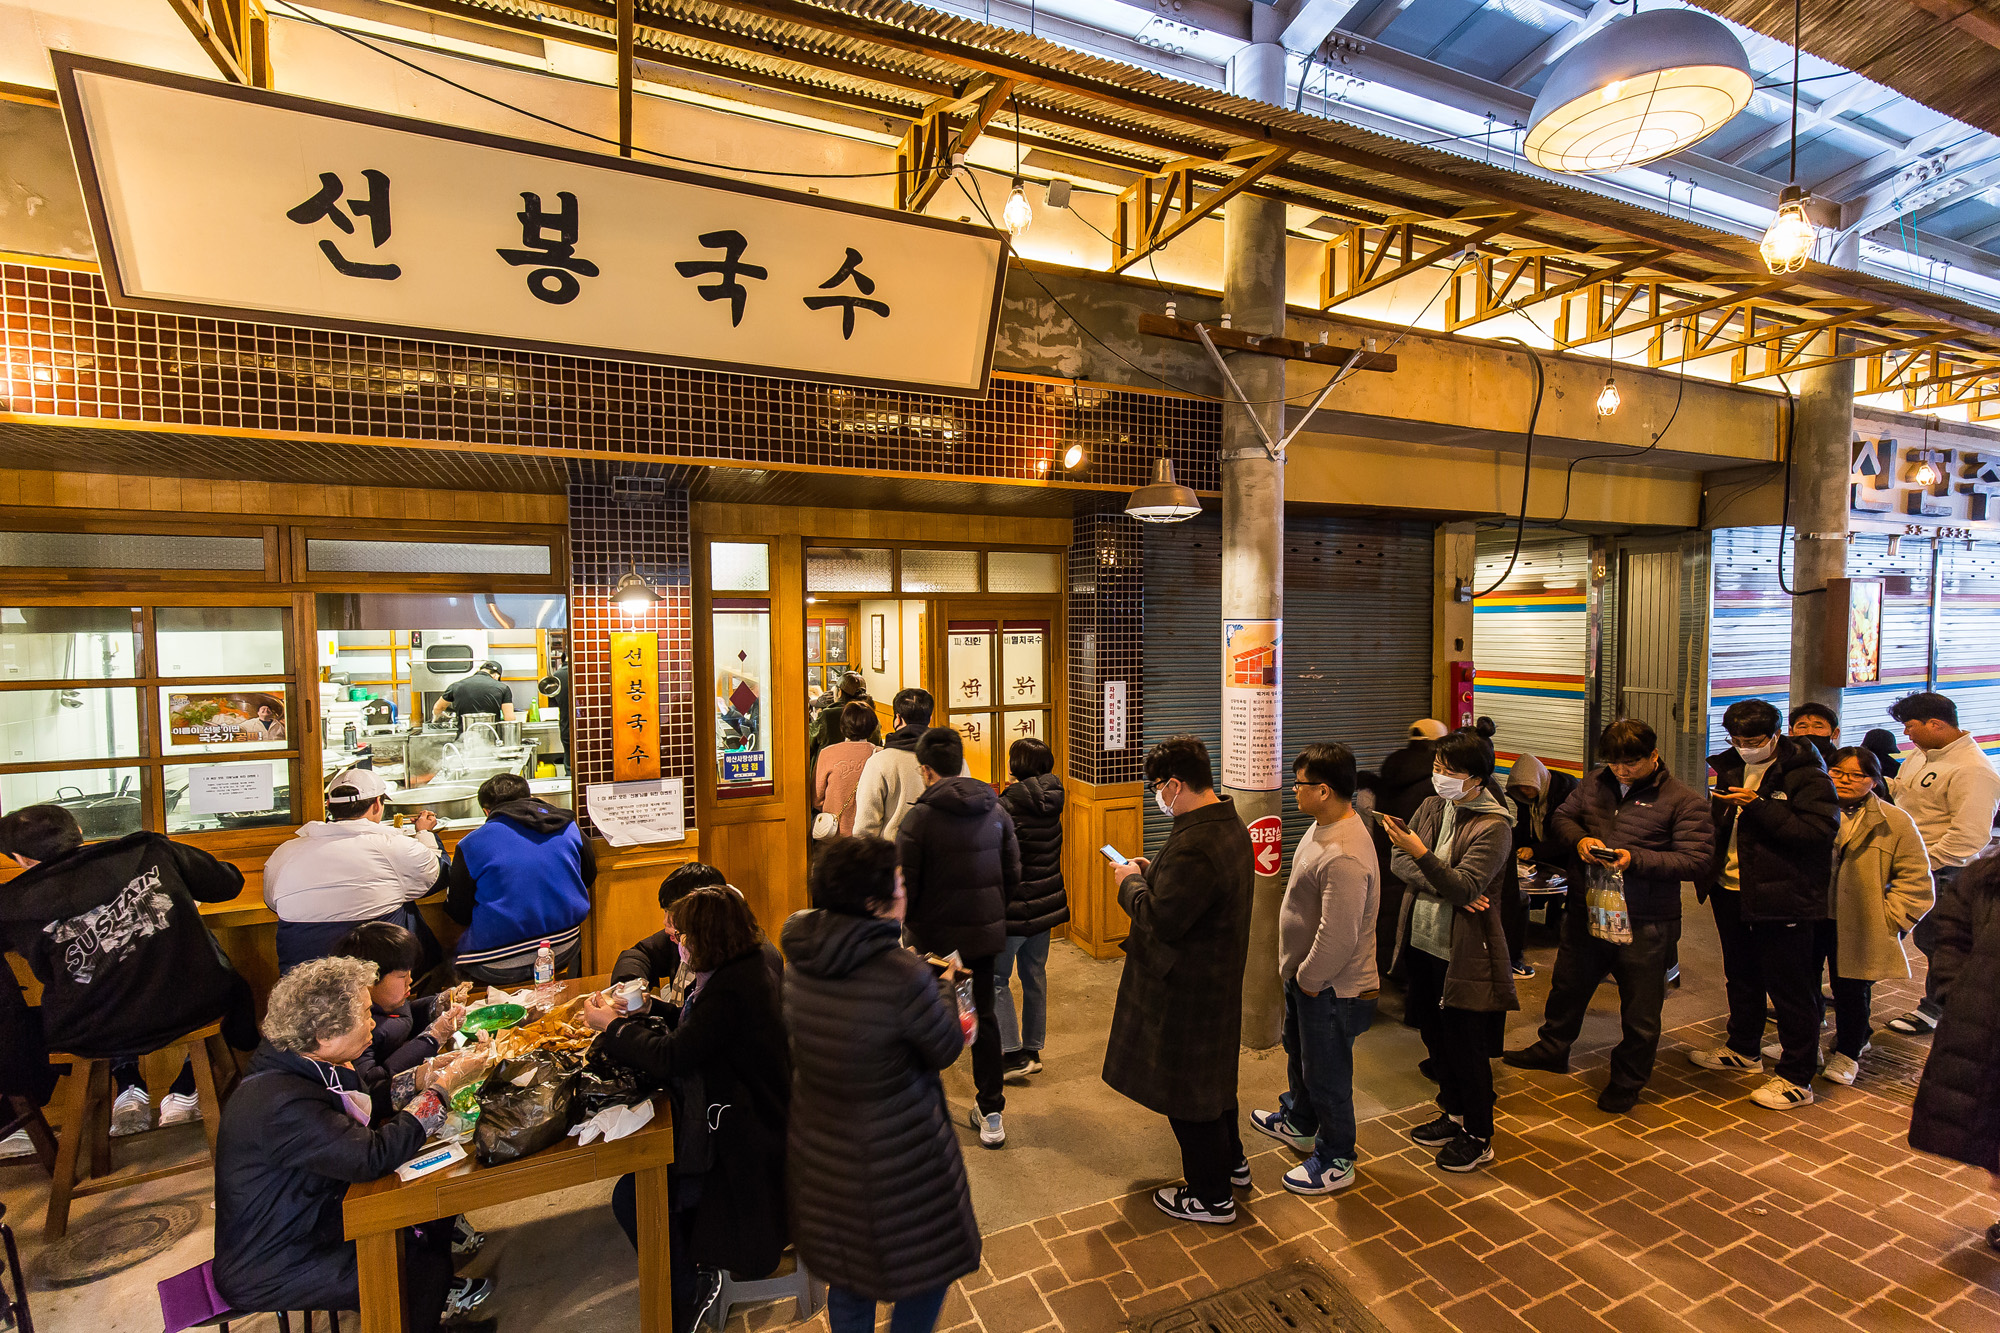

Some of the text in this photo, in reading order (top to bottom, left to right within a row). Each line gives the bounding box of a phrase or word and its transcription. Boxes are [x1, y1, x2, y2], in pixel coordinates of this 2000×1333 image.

[286, 169, 890, 341] 선봉국수
[1012, 636, 1042, 644] 멸치국수
[1109, 686, 1115, 699] 자리
[624, 648, 649, 764] 선봉국수
[1109, 702, 1114, 716] 먼저
[172, 727, 200, 735] 이름이
[199, 733, 233, 742] 국수가
[732, 763, 758, 772] 가맹점
[1920, 772, 1937, 788] C
[65, 864, 160, 974] SUSTAIN
